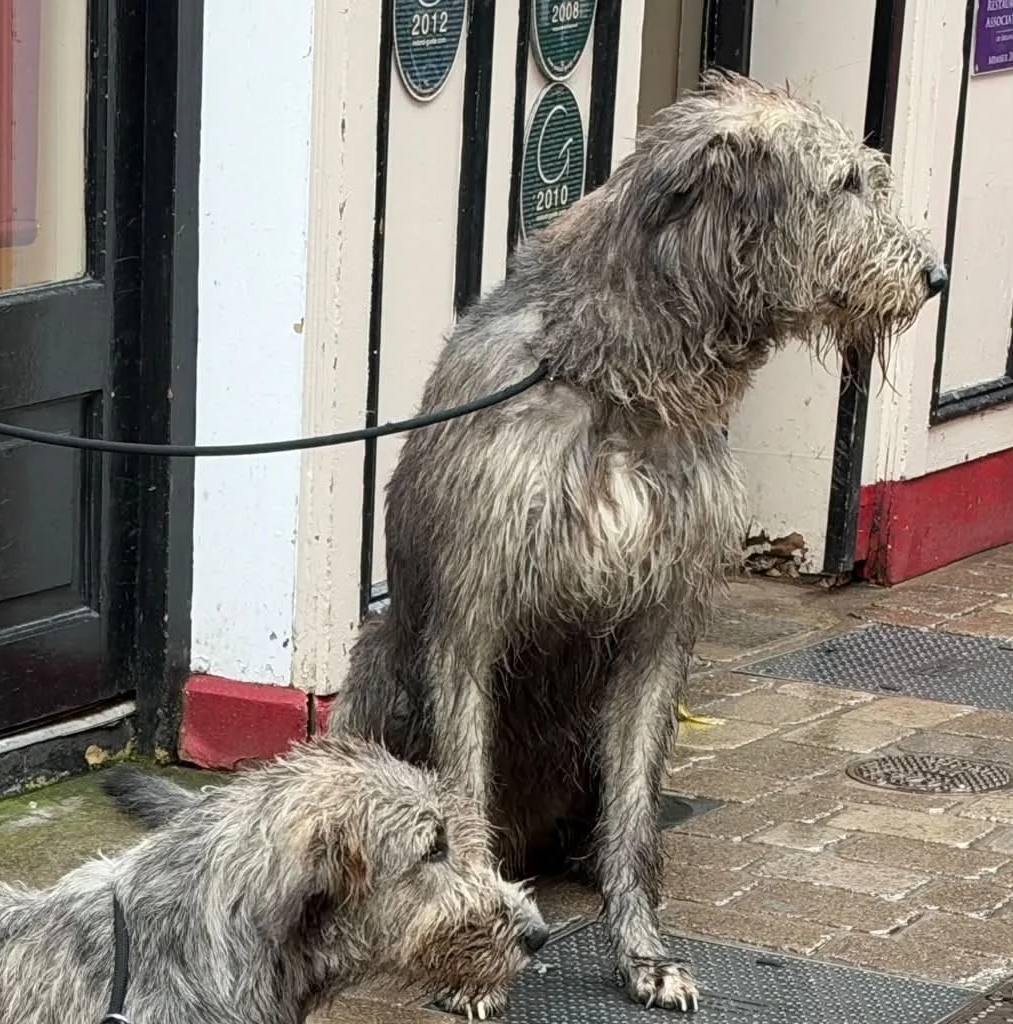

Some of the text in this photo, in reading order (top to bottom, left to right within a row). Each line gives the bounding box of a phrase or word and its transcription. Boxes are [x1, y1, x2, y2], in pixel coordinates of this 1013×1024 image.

[411, 11, 448, 36] 2012
[551, 1, 579, 23] 2008
[985, 14, 1013, 28] ASSOCIA
[536, 185, 568, 211] 2010
